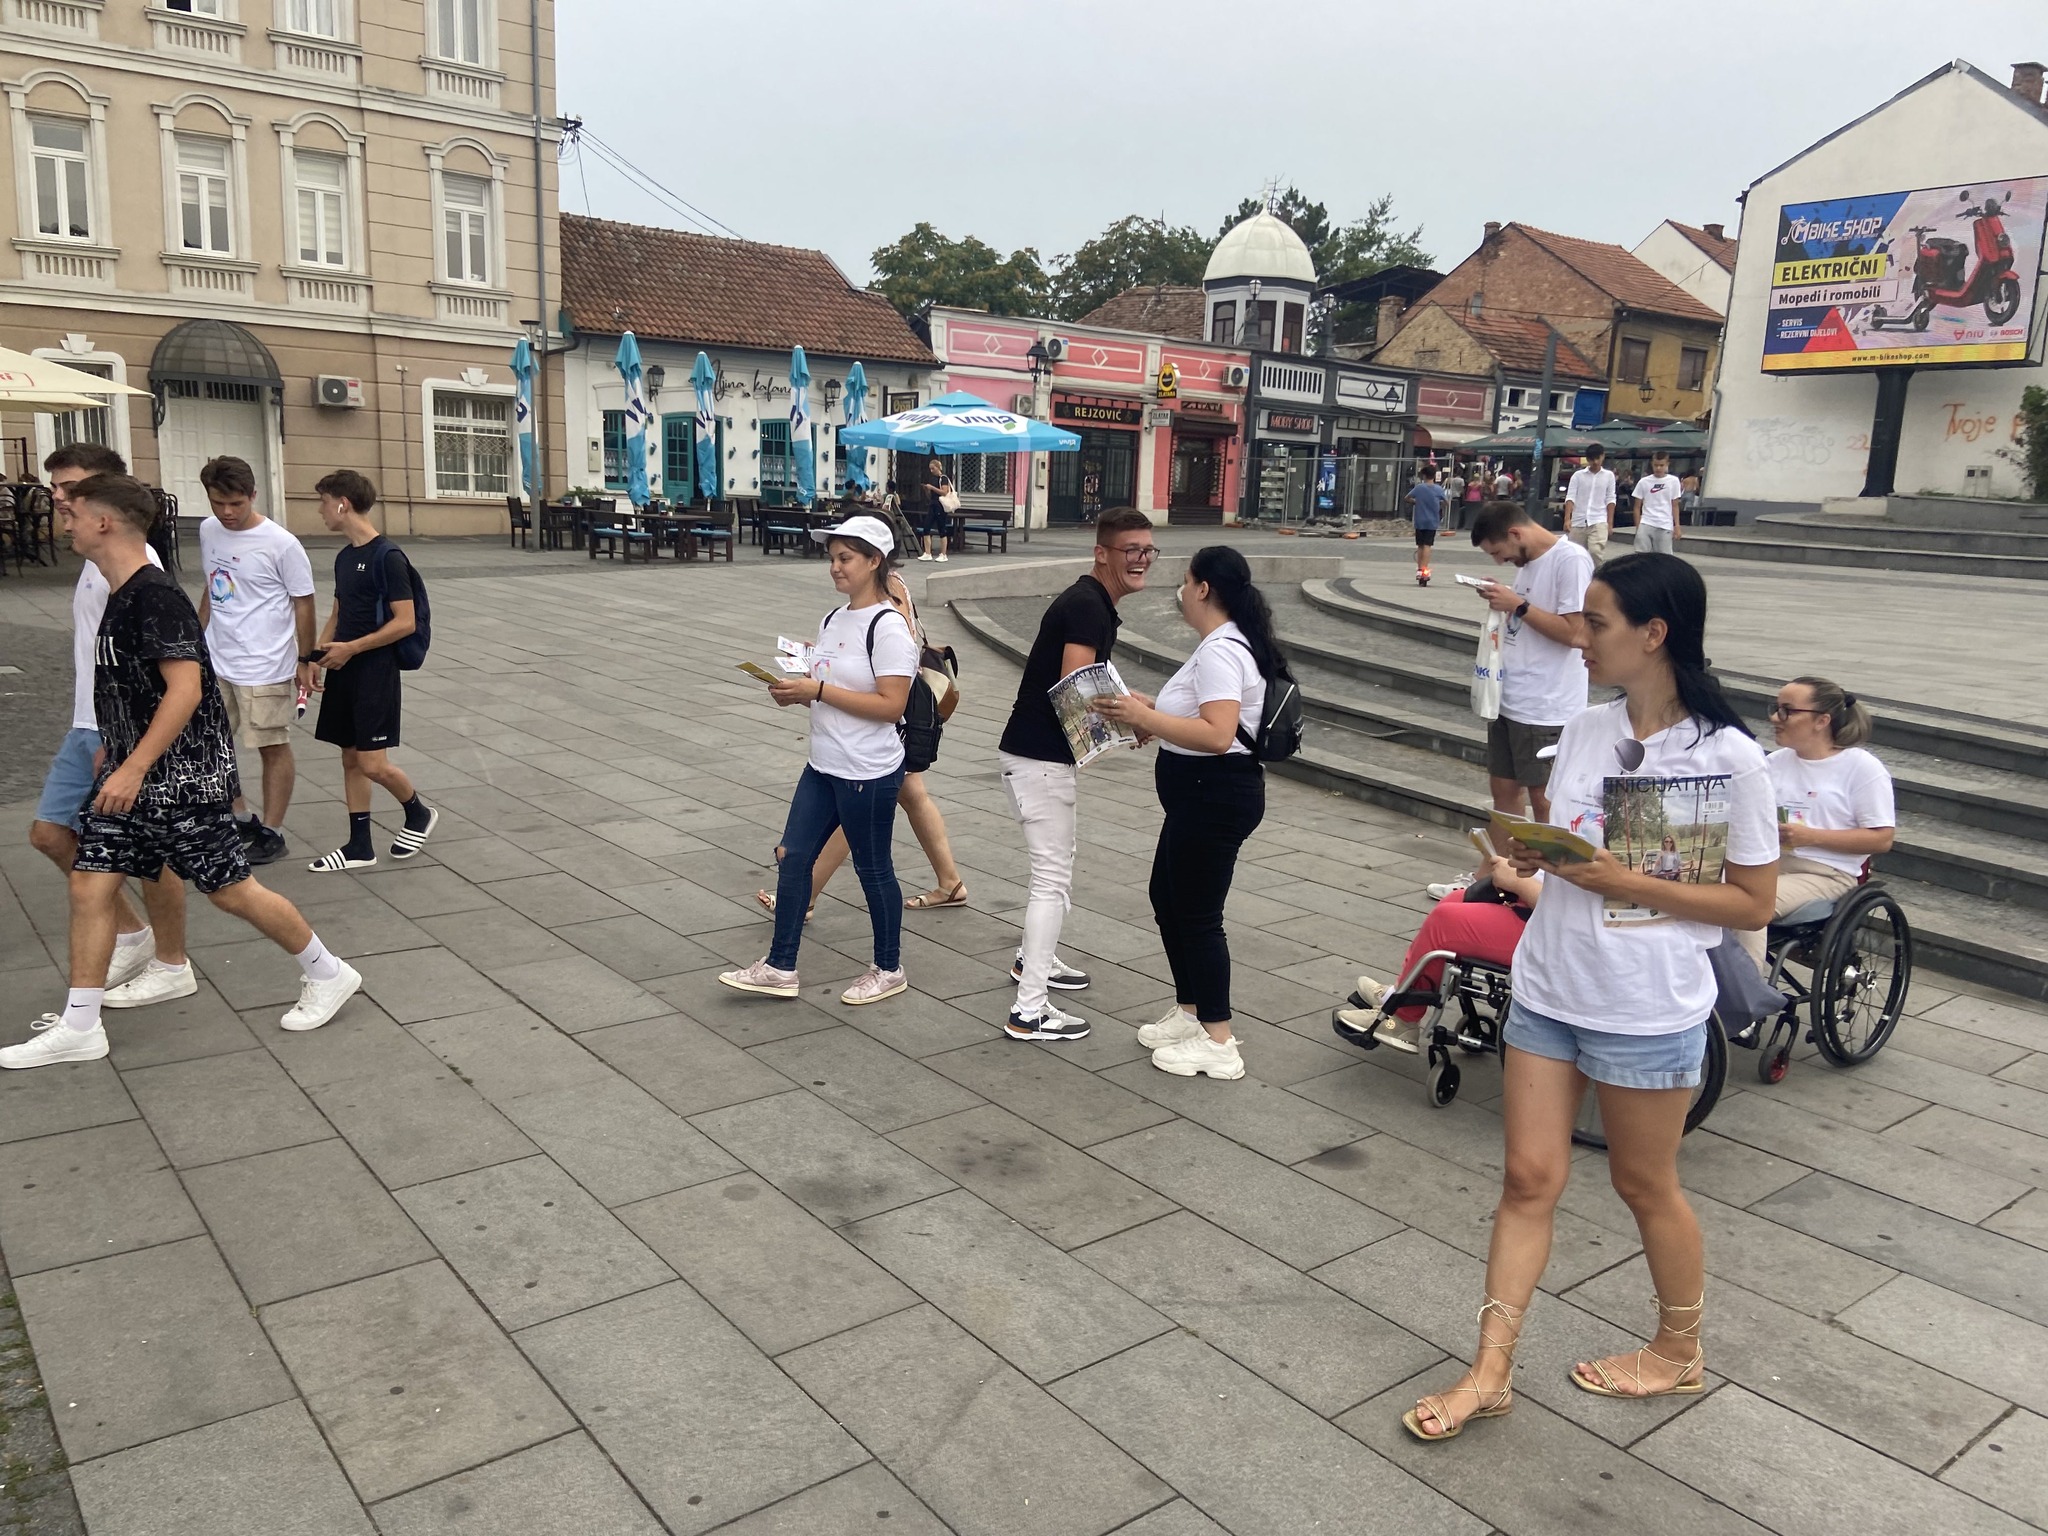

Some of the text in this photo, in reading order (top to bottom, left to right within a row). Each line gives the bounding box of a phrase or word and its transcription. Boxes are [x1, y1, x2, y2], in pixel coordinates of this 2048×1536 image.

[1842, 216, 1883, 238] SHOP
[1781, 256, 1878, 282] ELEKTRIČNI
[1779, 285, 1881, 306] Mopedi i romobili
[1781, 318, 1803, 327] SERVIS
[1780, 327, 1838, 339] REZERVNI DIJELOVI
[1851, 353, 1930, 362] www.m-bikeshop.com
[1074, 406, 1122, 421] REJZOVIĆ
[1942, 403, 1996, 442] Tvoje
[1609, 775, 1726, 794] INICIJATIVA
